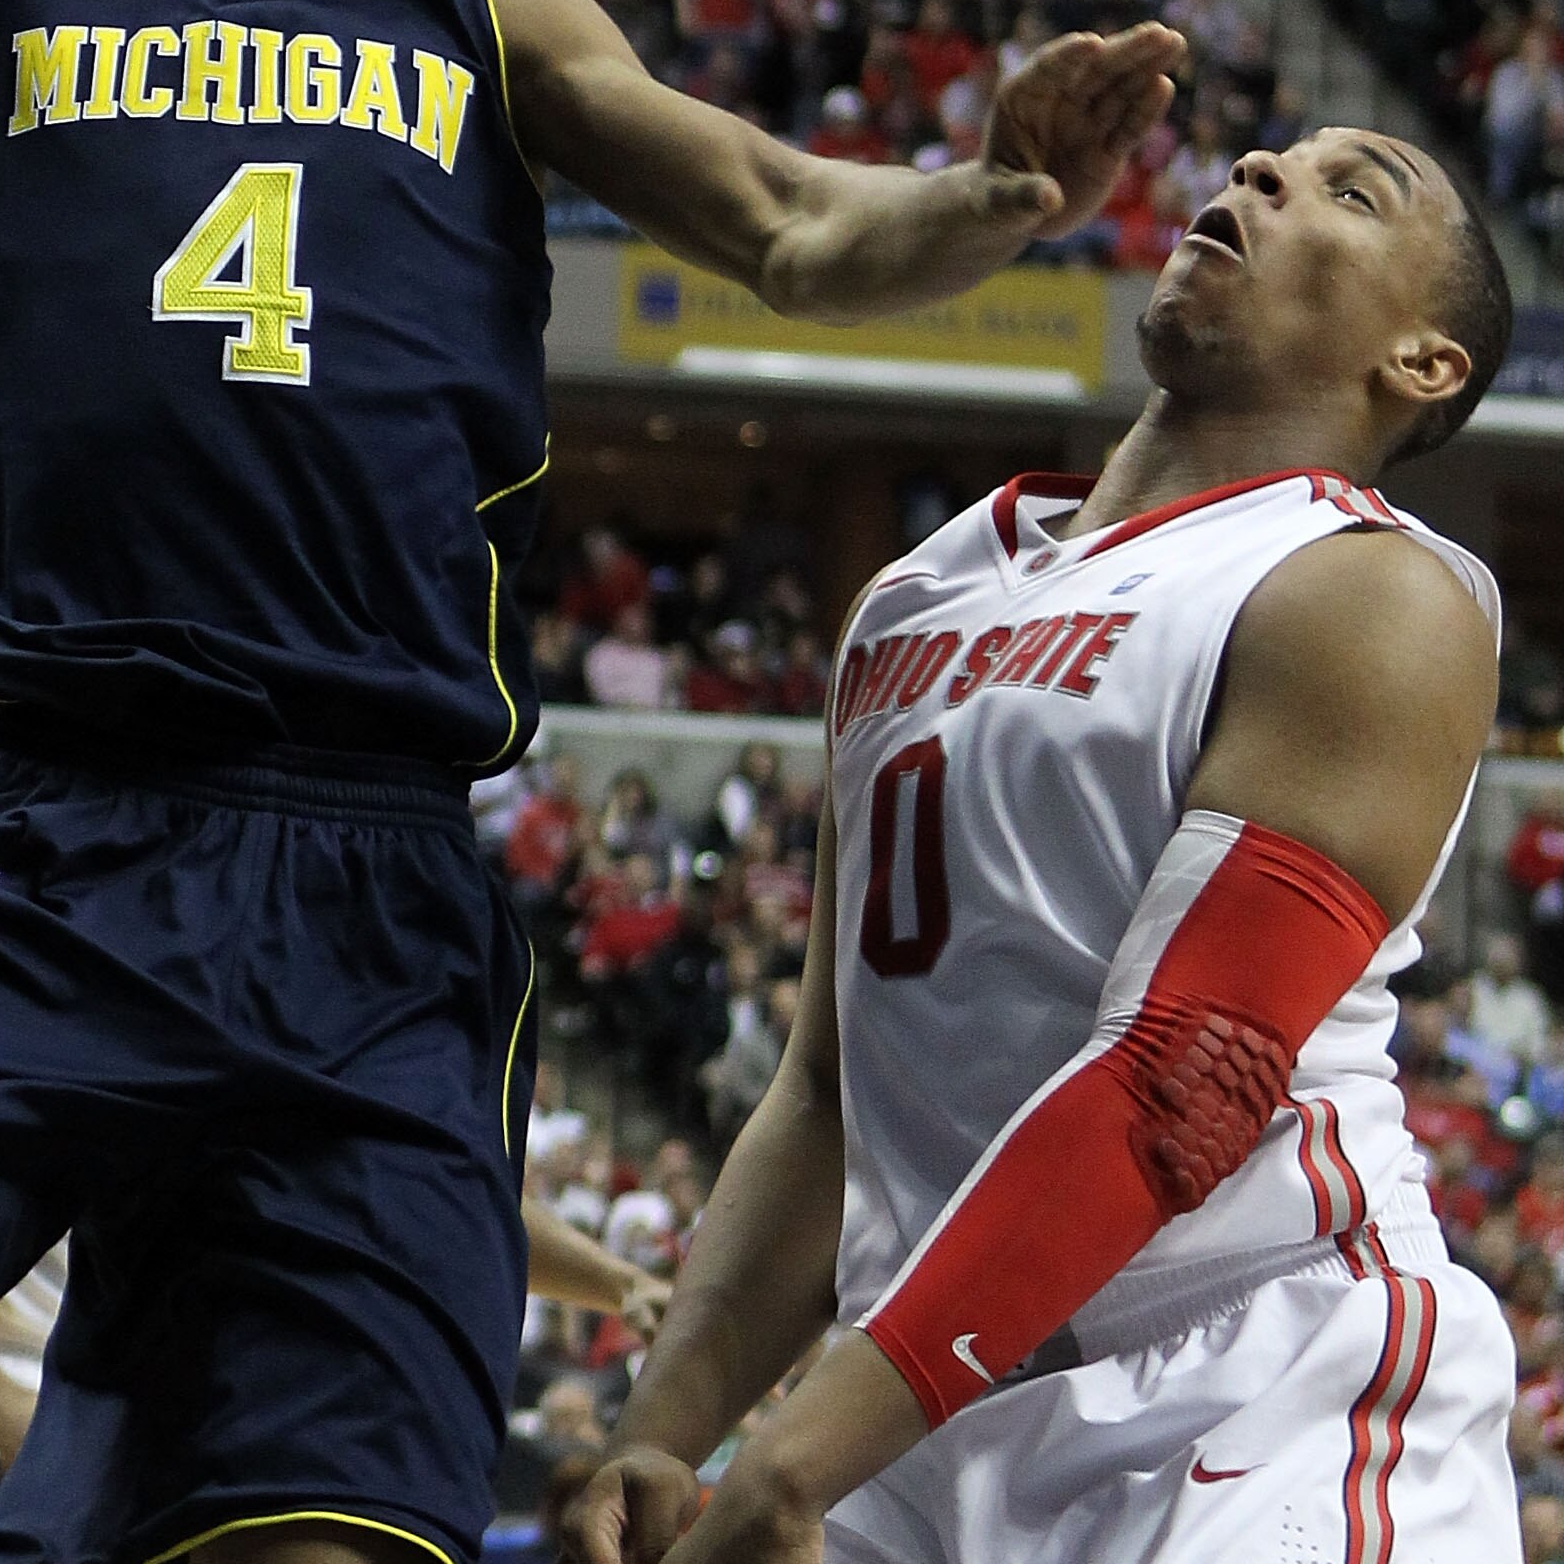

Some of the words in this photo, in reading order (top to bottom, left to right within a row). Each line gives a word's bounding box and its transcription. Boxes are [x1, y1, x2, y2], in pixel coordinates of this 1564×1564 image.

[8, 20, 474, 175] MICHIGAN
[152, 163, 313, 386] 4
[836, 629, 964, 737] OHIO
[945, 609, 1141, 709] STATE
[859, 735, 950, 978] 0
